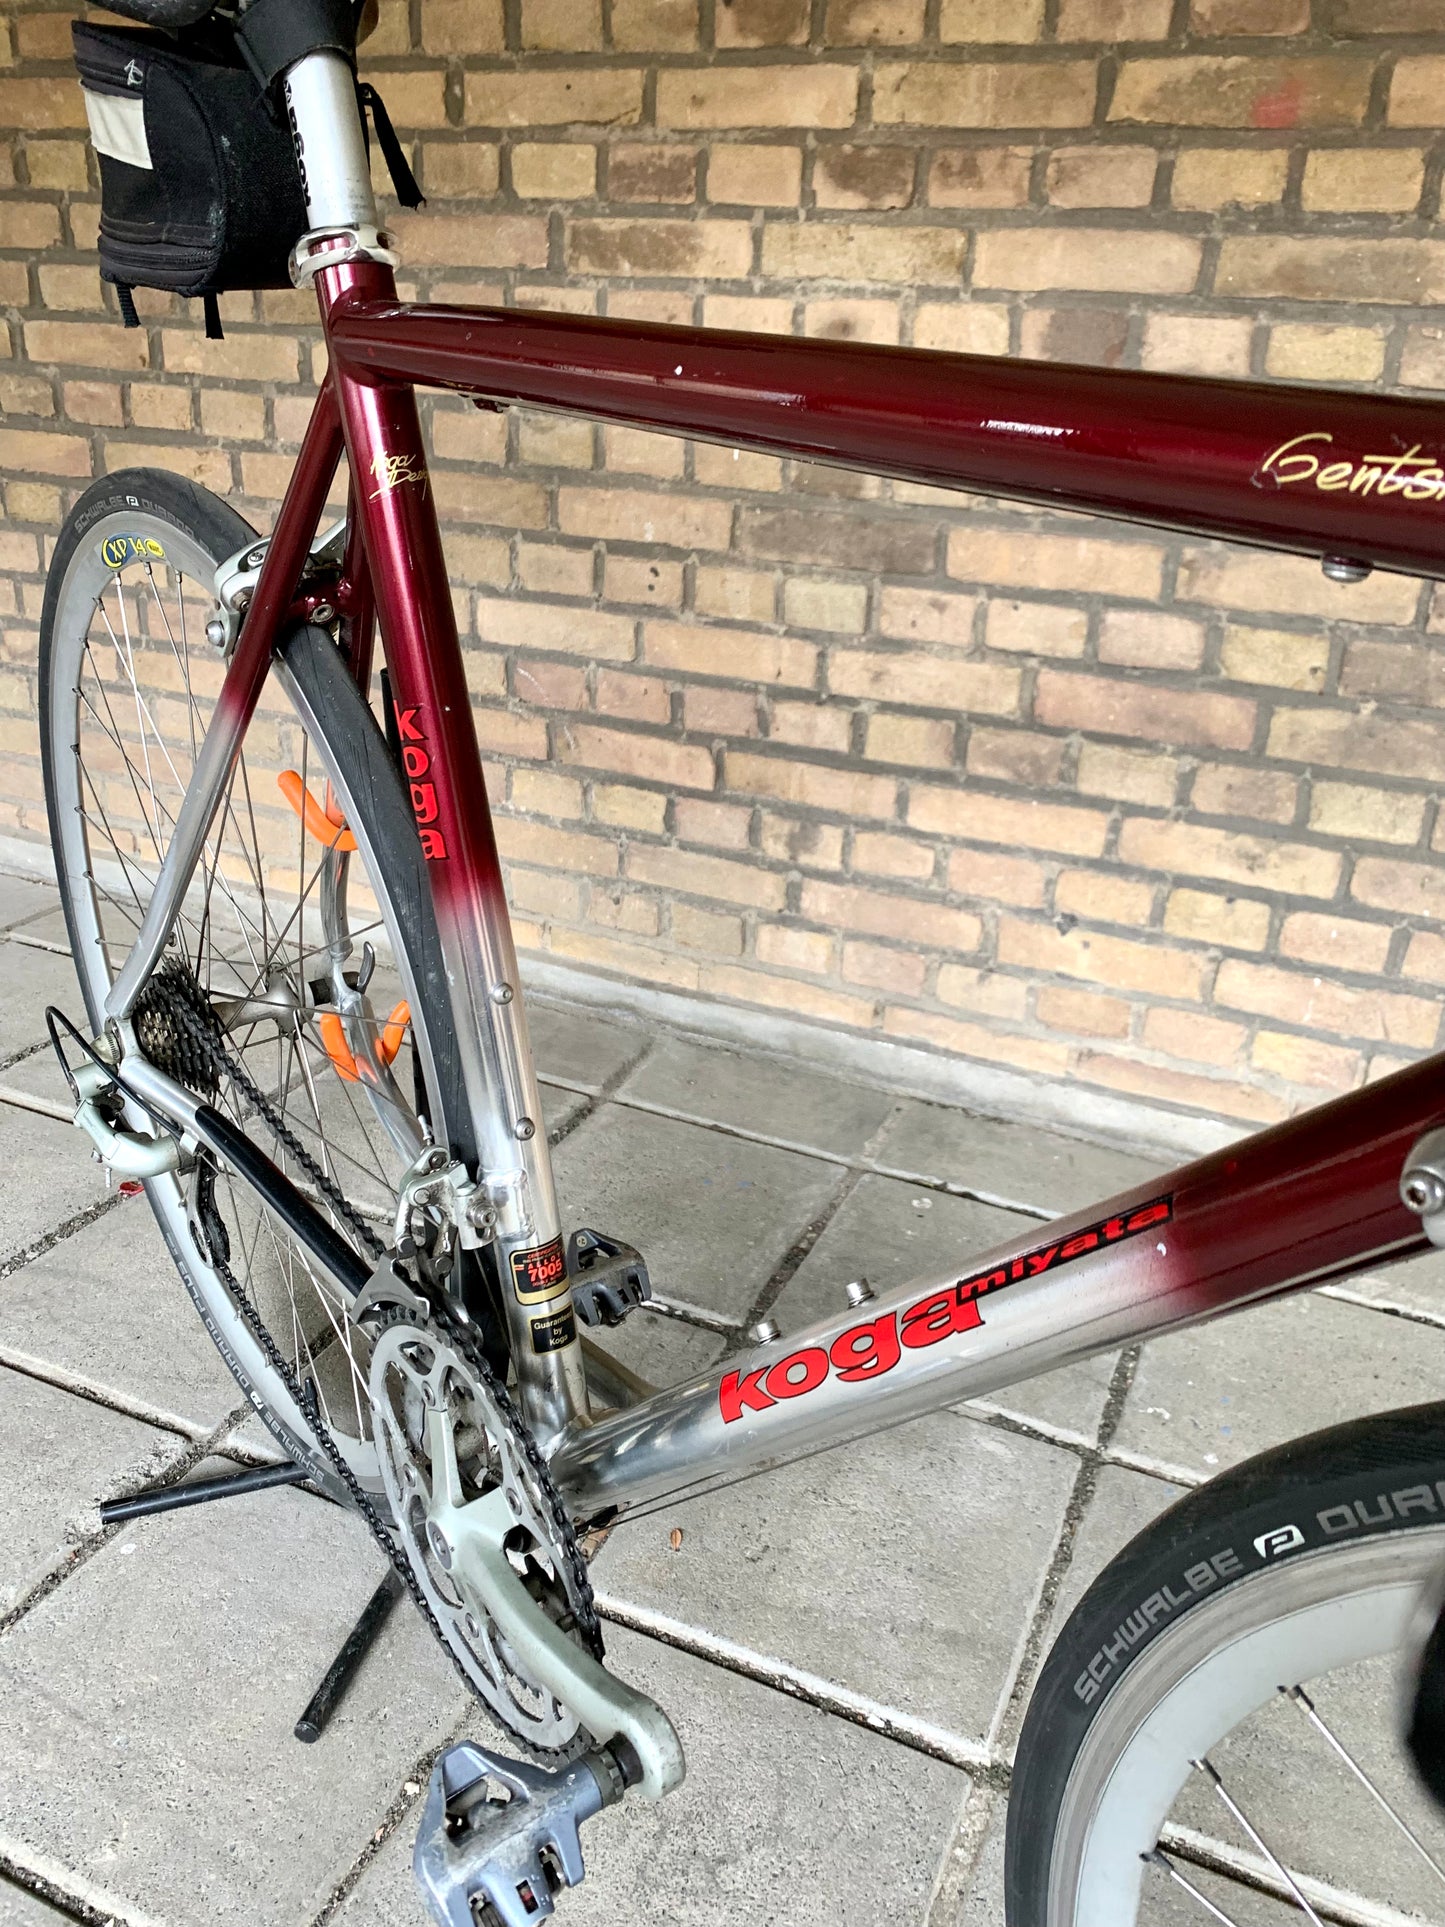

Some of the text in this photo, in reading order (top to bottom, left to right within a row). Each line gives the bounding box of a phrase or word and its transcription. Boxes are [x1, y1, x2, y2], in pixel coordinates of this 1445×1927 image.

[74, 495, 123, 534] SCHWALBE
[393, 699, 448, 861] koga
[177, 1261, 206, 1314] PLUS
[528, 1258, 562, 1283] 7005
[549, 1334, 568, 1346] Koga
[553, 1327, 563, 1336] by
[718, 1202, 1171, 1425] koga miyata
[204, 1317, 250, 1389] DURANO
[264, 1411, 325, 1483] SCHWALBE
[1073, 1548, 1245, 1705] SCHWALBE
